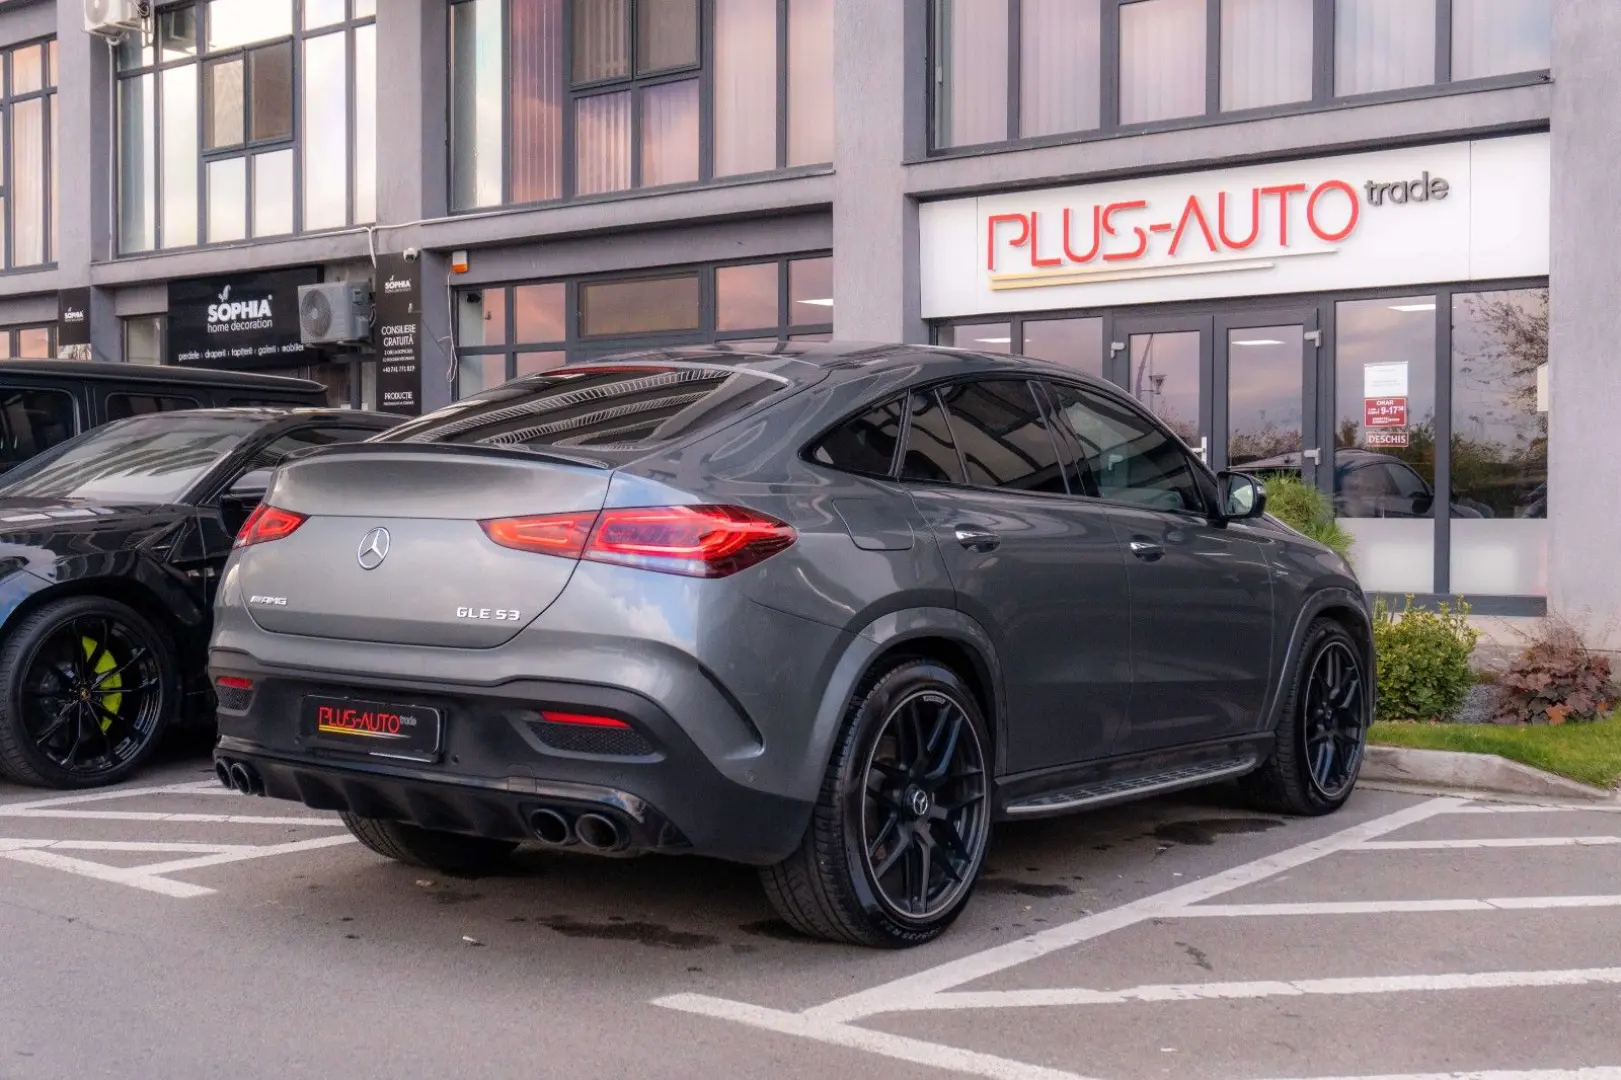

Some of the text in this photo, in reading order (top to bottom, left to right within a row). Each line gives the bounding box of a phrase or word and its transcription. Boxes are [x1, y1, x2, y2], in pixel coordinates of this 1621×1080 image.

[987, 171, 1450, 271] PLUS-AUTO trade
[207, 299, 272, 323] SOPHIA
[207, 317, 273, 333] home decoration
[381, 323, 416, 335] CONSILIERE
[1368, 435, 1406, 444] DESCHIS
[456, 607, 520, 621] GLE 53
[318, 706, 400, 734] PLUS-AUTO
